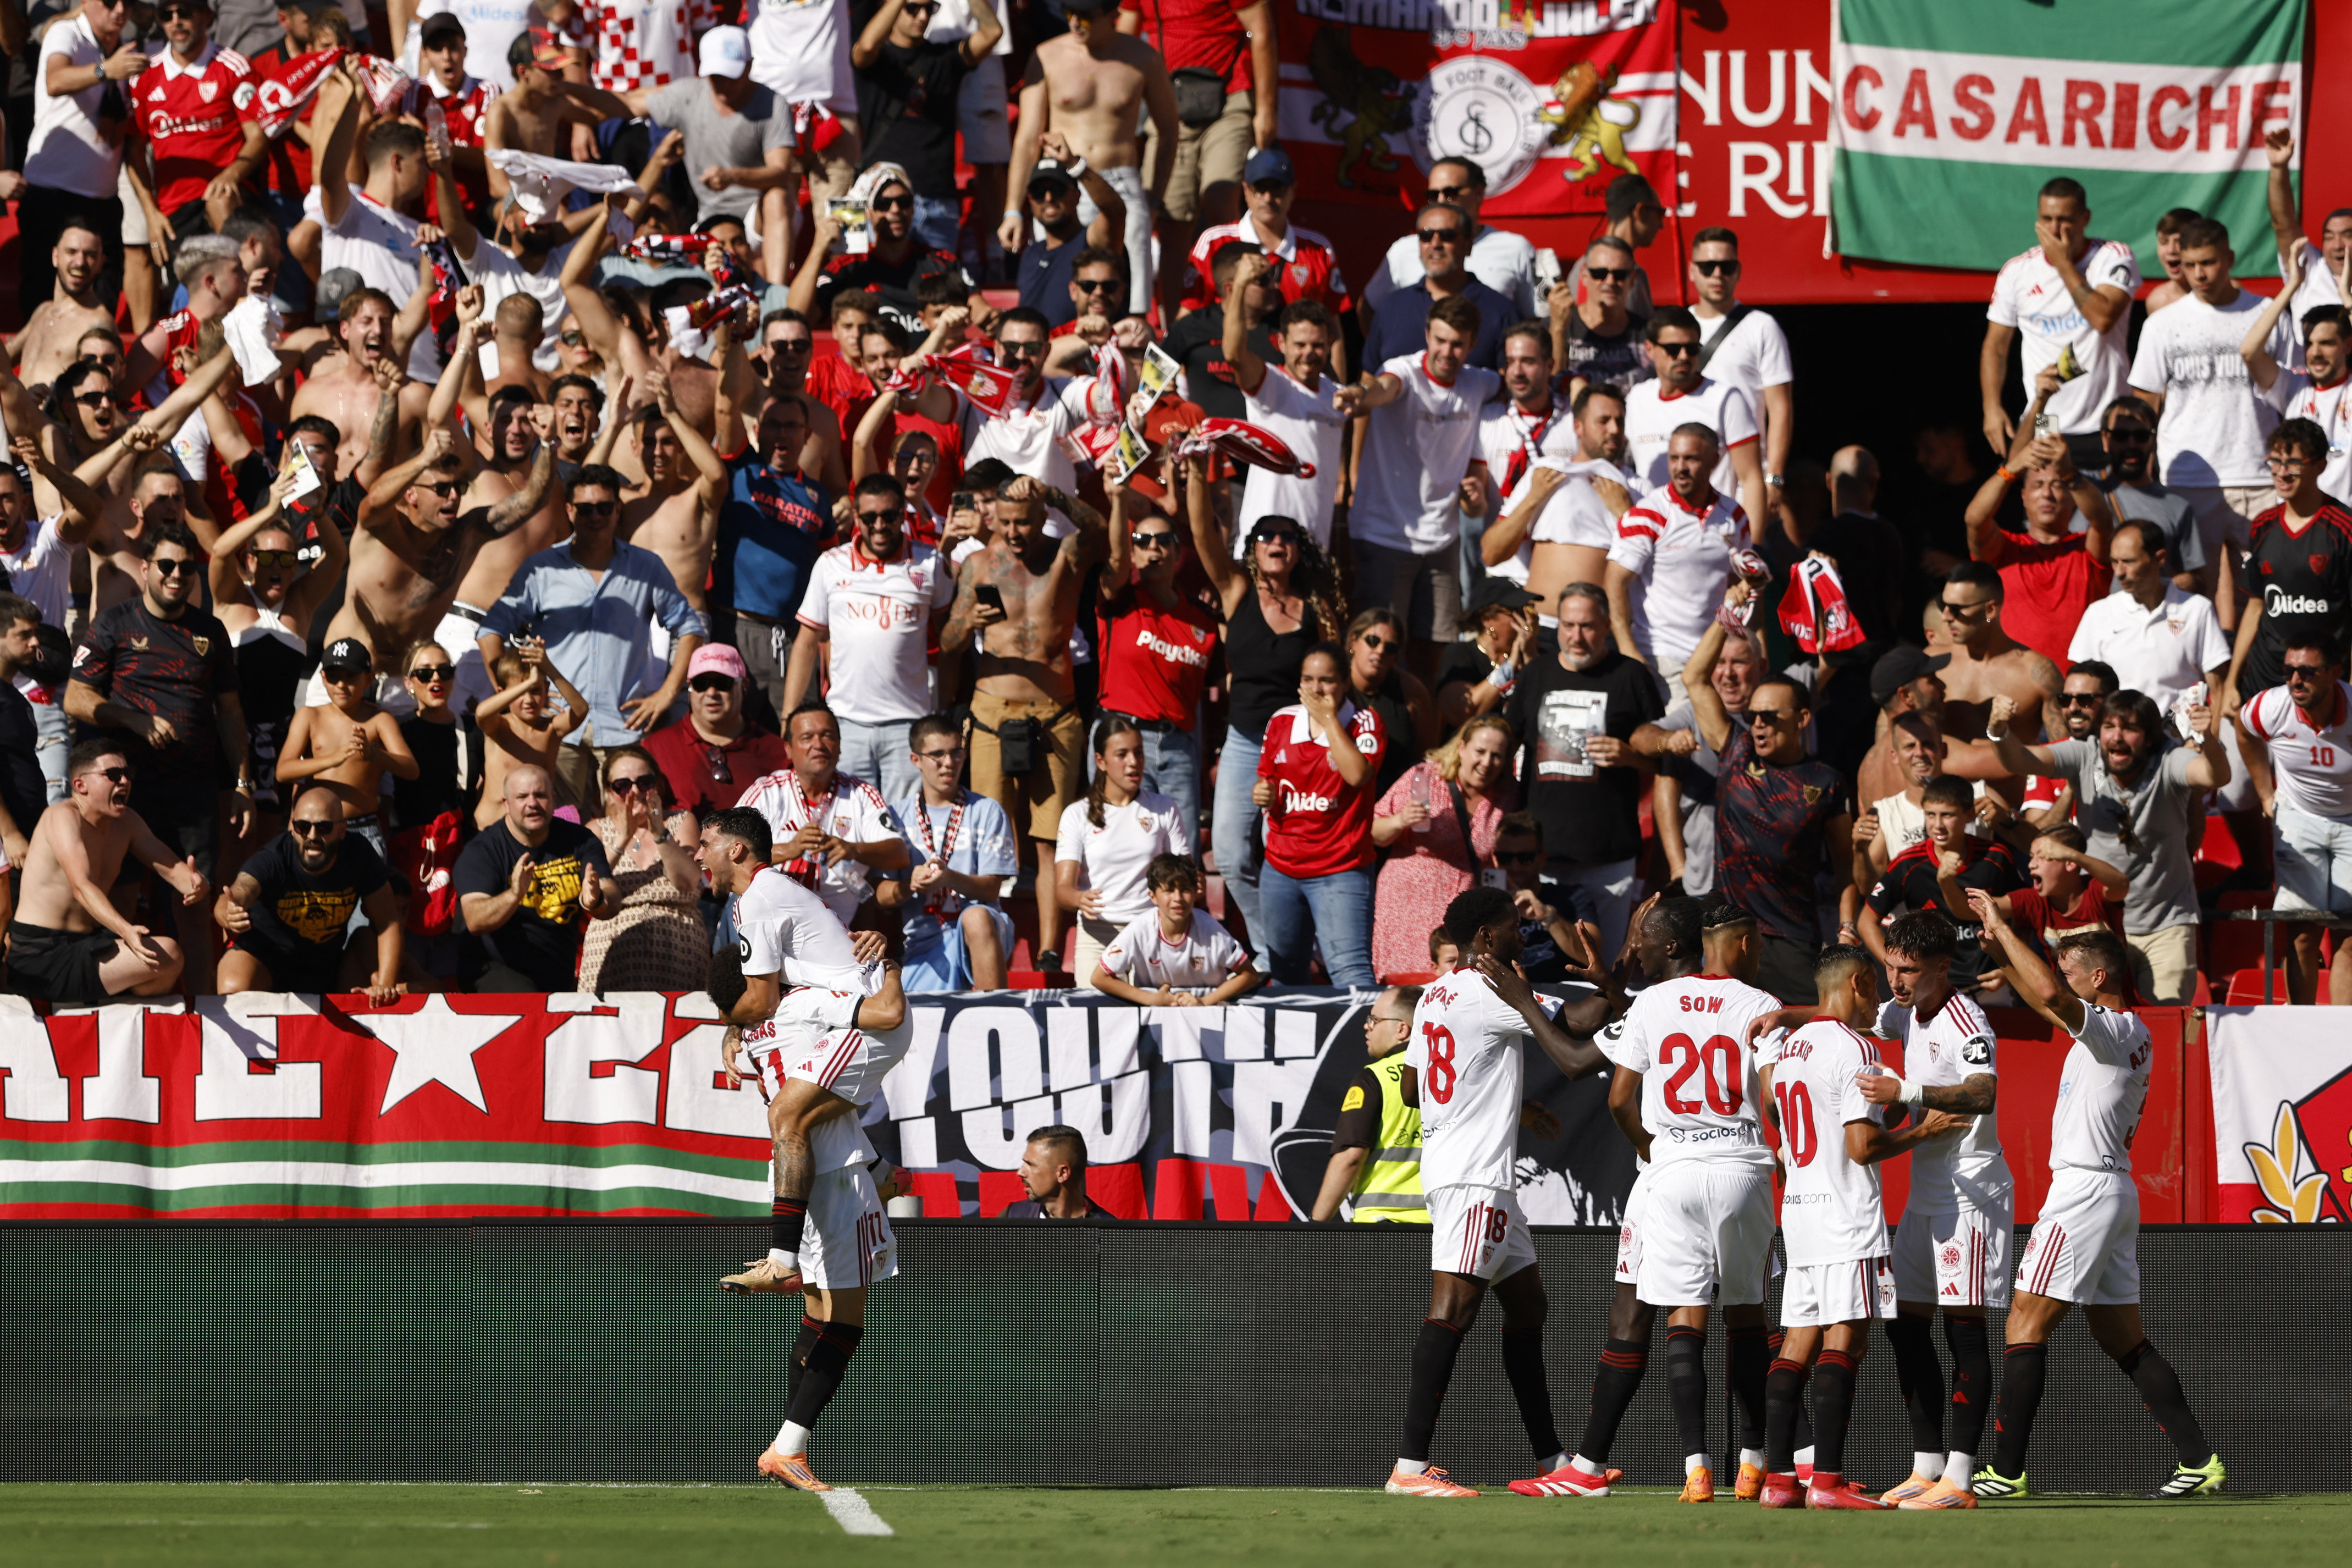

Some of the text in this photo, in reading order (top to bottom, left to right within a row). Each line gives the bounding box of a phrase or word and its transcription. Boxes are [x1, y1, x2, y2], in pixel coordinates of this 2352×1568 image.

[1445, 68, 1487, 89] FOOT
[1842, 64, 2292, 152] CASARICHE
[2265, 584, 2328, 617] Midea
[2310, 746, 2335, 768] 10
[1279, 779, 1338, 814] Midea
[1680, 995, 1724, 1014] SOW
[1422, 1021, 1456, 1105] 18
[1776, 1040, 1813, 1065] ALEXIS
[881, 1005, 1318, 1171] YOUTH
[1659, 1032, 1743, 1116] 20
[1775, 1080, 1818, 1168] 10
[1484, 1206, 1508, 1244] 18
[1952, 1238, 1965, 1248] TIME
